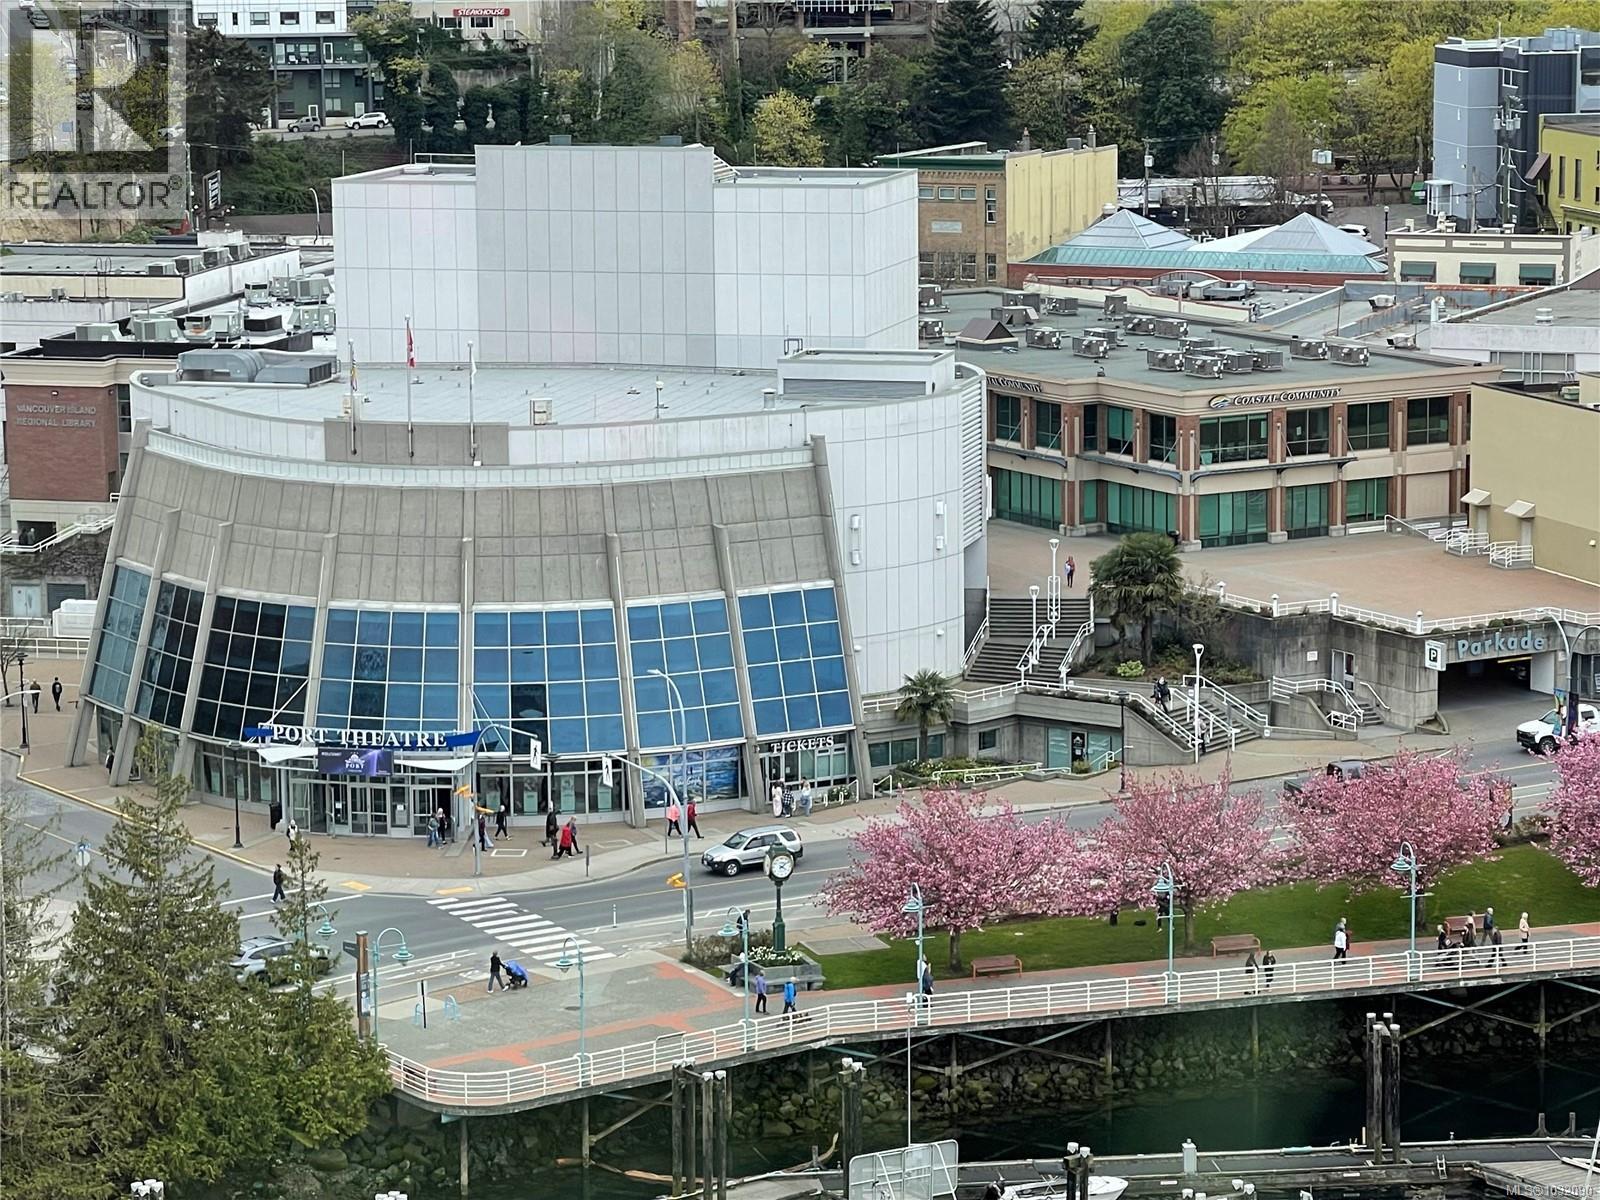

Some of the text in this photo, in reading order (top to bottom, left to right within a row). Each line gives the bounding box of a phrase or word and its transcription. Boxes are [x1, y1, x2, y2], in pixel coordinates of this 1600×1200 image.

[457, 8, 505, 16] STEAKHOUSE
[1233, 388, 1341, 406] COASTAL COMMUNITY
[16, 404, 96, 415] VANCOUVER ISLAND
[16, 418, 96, 428] REGIONAL LIBRARY
[1457, 630, 1545, 658] Parkade
[273, 725, 328, 744] PORT
[337, 729, 447, 748] THEATRE
[771, 735, 834, 754] TICKETS
